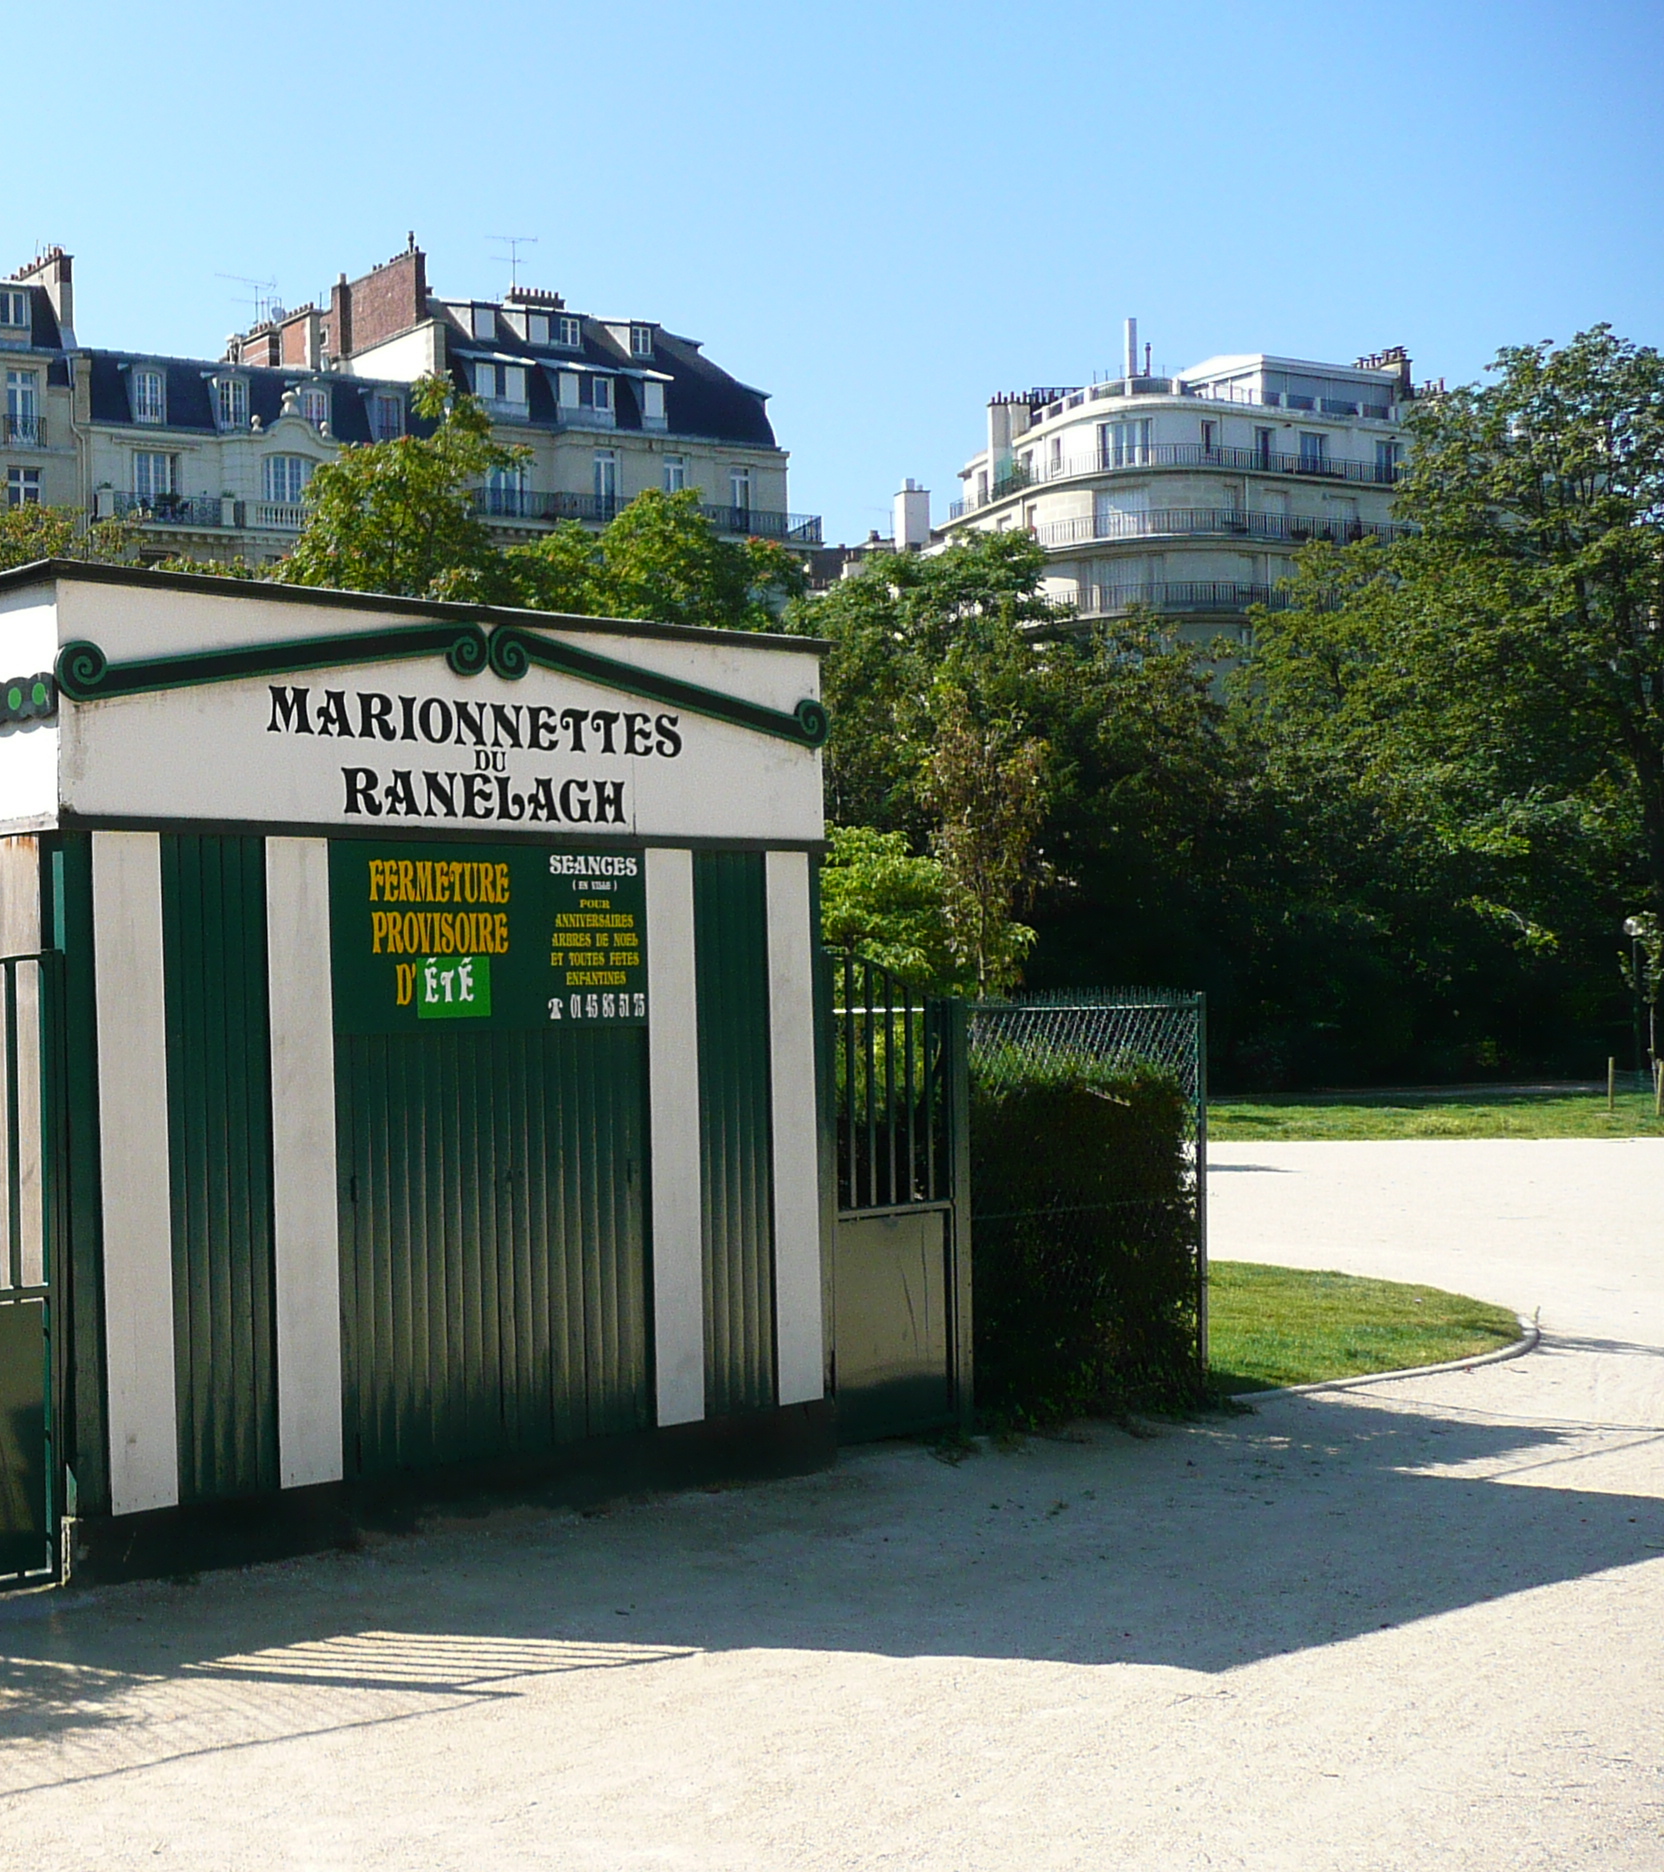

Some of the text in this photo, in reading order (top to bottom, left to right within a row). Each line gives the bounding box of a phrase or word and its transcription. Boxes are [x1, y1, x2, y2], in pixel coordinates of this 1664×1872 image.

[267, 685, 682, 758] MARIONNETTES
[475, 749, 506, 772] DU
[341, 767, 625, 824] RANELAGH
[549, 854, 638, 876] SEANCES
[369, 859, 510, 903] FERMETURE
[579, 899, 611, 909] POUR
[555, 913, 634, 928] ANNIVERSAIRES
[372, 911, 509, 954] PROVISOIRE
[552, 932, 592, 947] ARBRES
[596, 933, 610, 947] DE
[550, 952, 564, 966] ET
[568, 952, 605, 967] TOUTES
[566, 971, 627, 986] ENFANTINES
[570, 993, 582, 1019] 01
[585, 993, 599, 1019] 45
